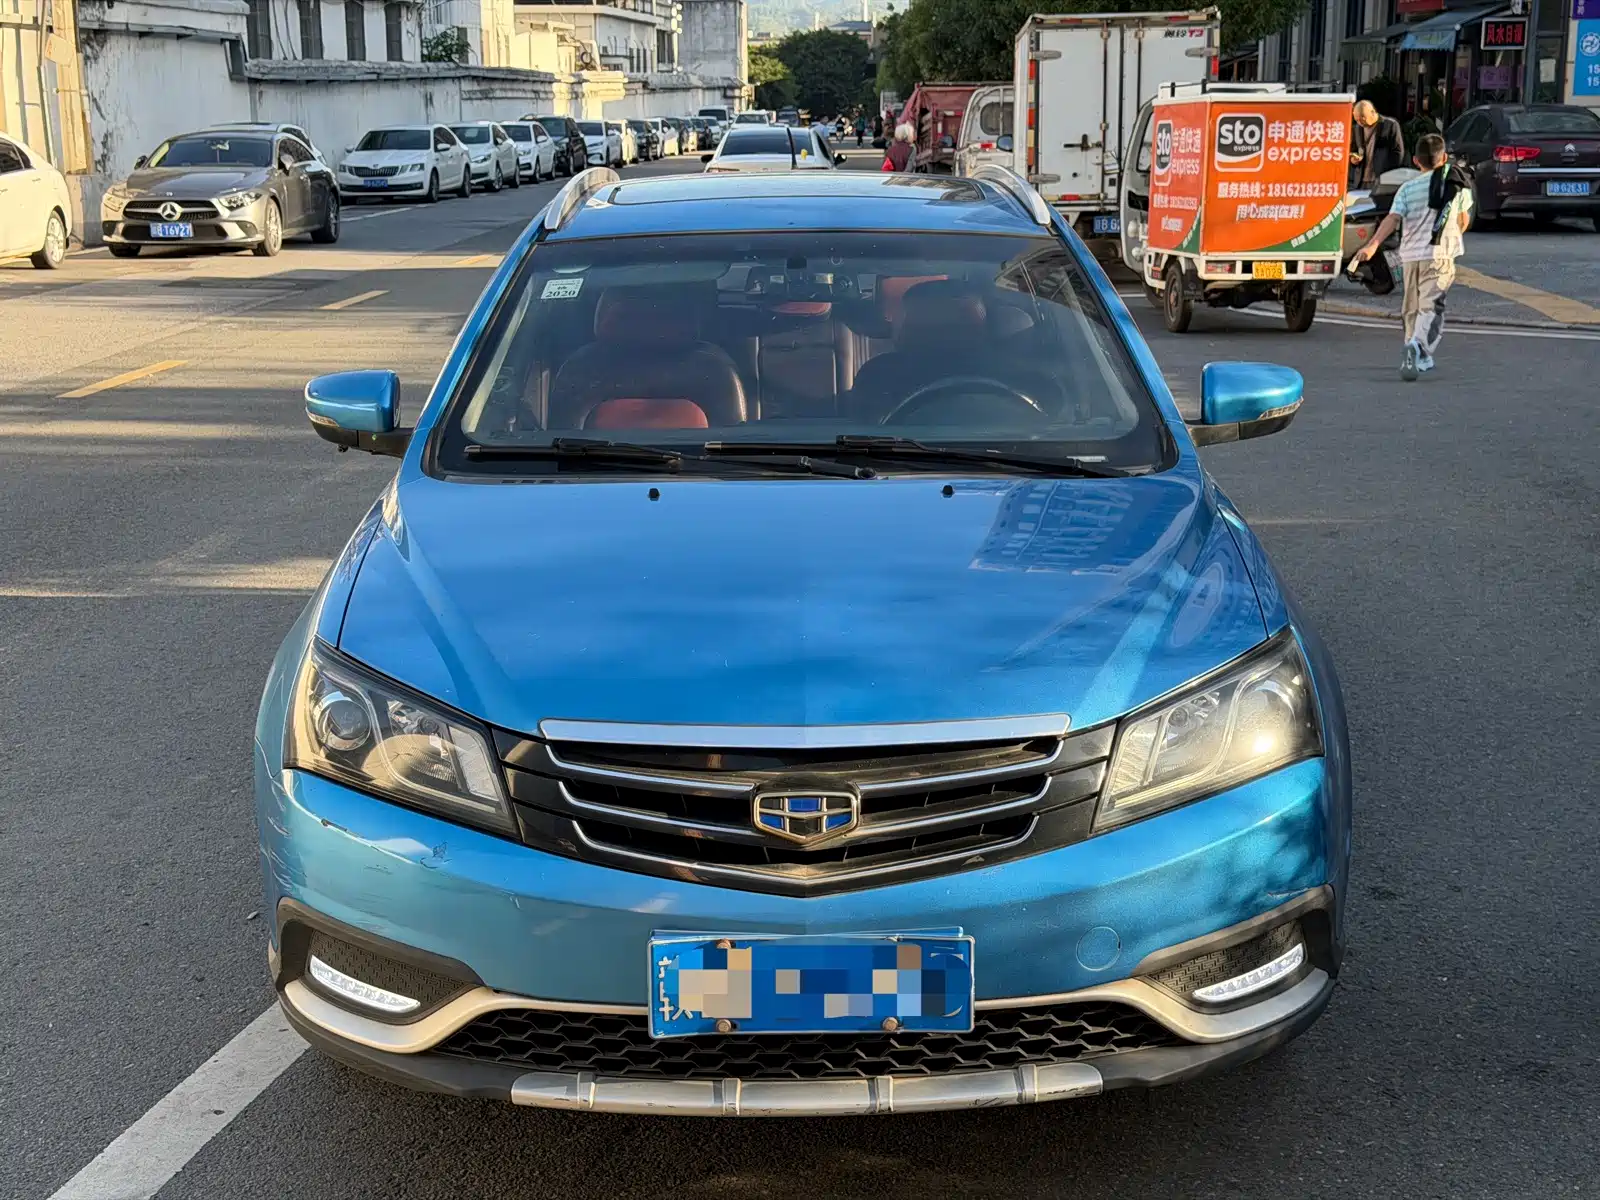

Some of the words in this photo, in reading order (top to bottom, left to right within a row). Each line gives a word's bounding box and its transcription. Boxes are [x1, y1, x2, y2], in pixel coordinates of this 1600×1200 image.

[1220, 120, 1261, 145] sto
[1267, 121, 1345, 144] 申通快递
[1267, 146, 1344, 165] express
[545, 290, 576, 298] 2020
